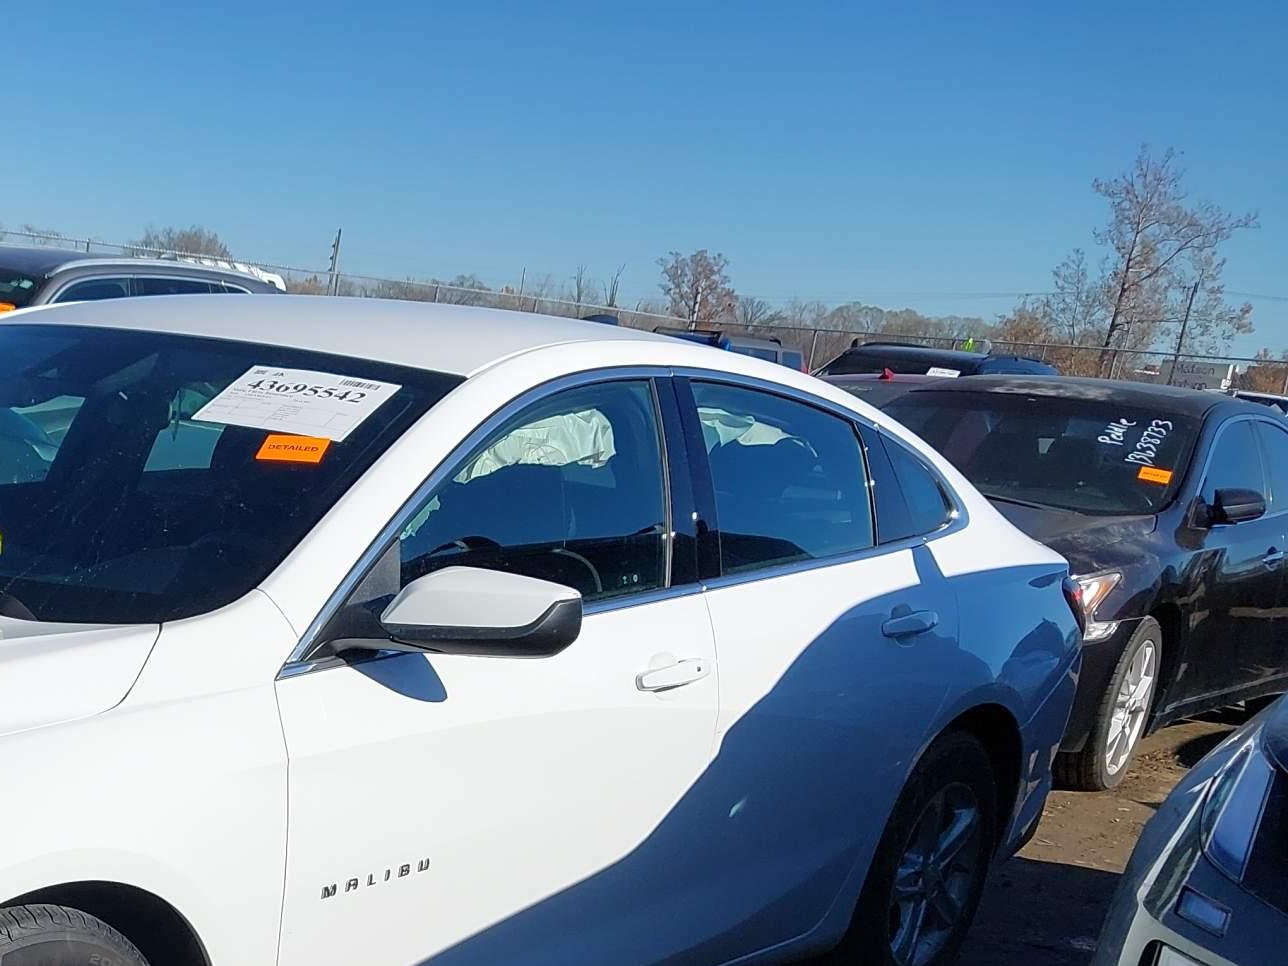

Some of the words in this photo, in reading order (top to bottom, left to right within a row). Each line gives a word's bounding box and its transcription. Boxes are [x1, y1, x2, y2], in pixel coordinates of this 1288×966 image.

[247, 378, 366, 404] 43695542
[267, 443, 320, 453] DETAILED
[320, 857, 431, 900] MALIBU
